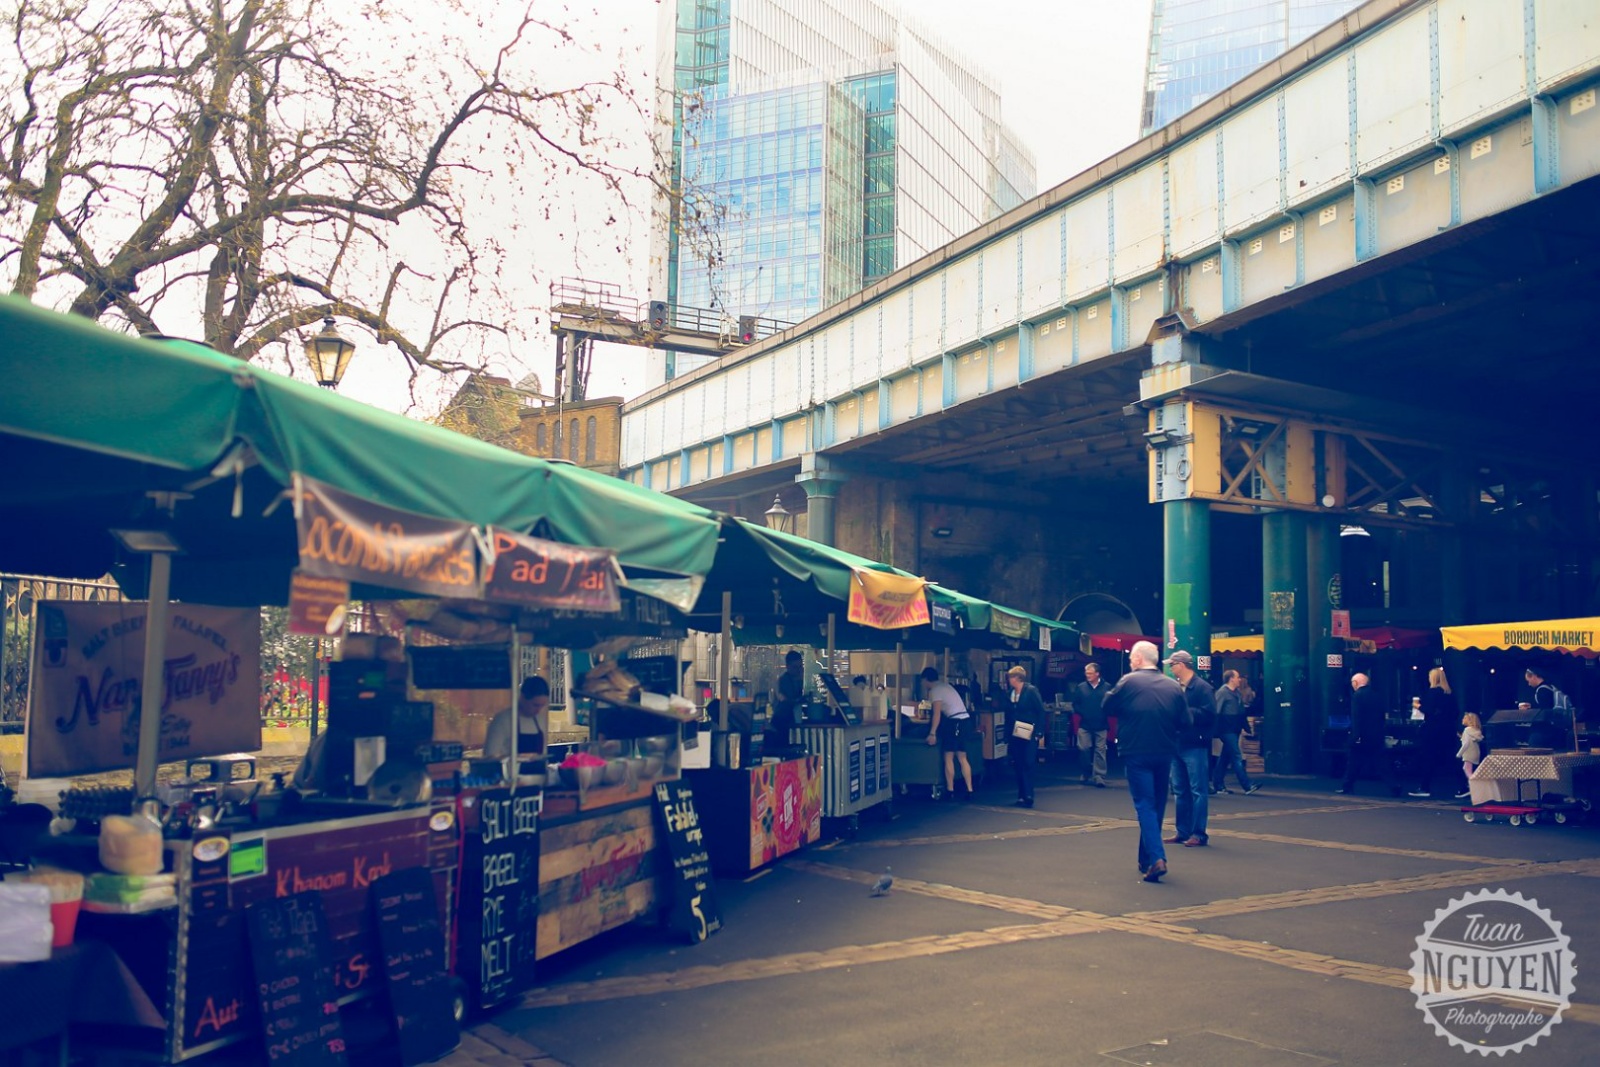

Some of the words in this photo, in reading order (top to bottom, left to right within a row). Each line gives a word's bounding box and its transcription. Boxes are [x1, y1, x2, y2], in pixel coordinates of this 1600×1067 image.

[485, 533, 549, 585] Pad
[1503, 630, 1549, 645] BOROUGH
[1551, 631, 1594, 646] MARKET
[481, 798, 511, 844] SALT
[482, 895, 505, 939] RYE
[481, 934, 515, 983] MELT
